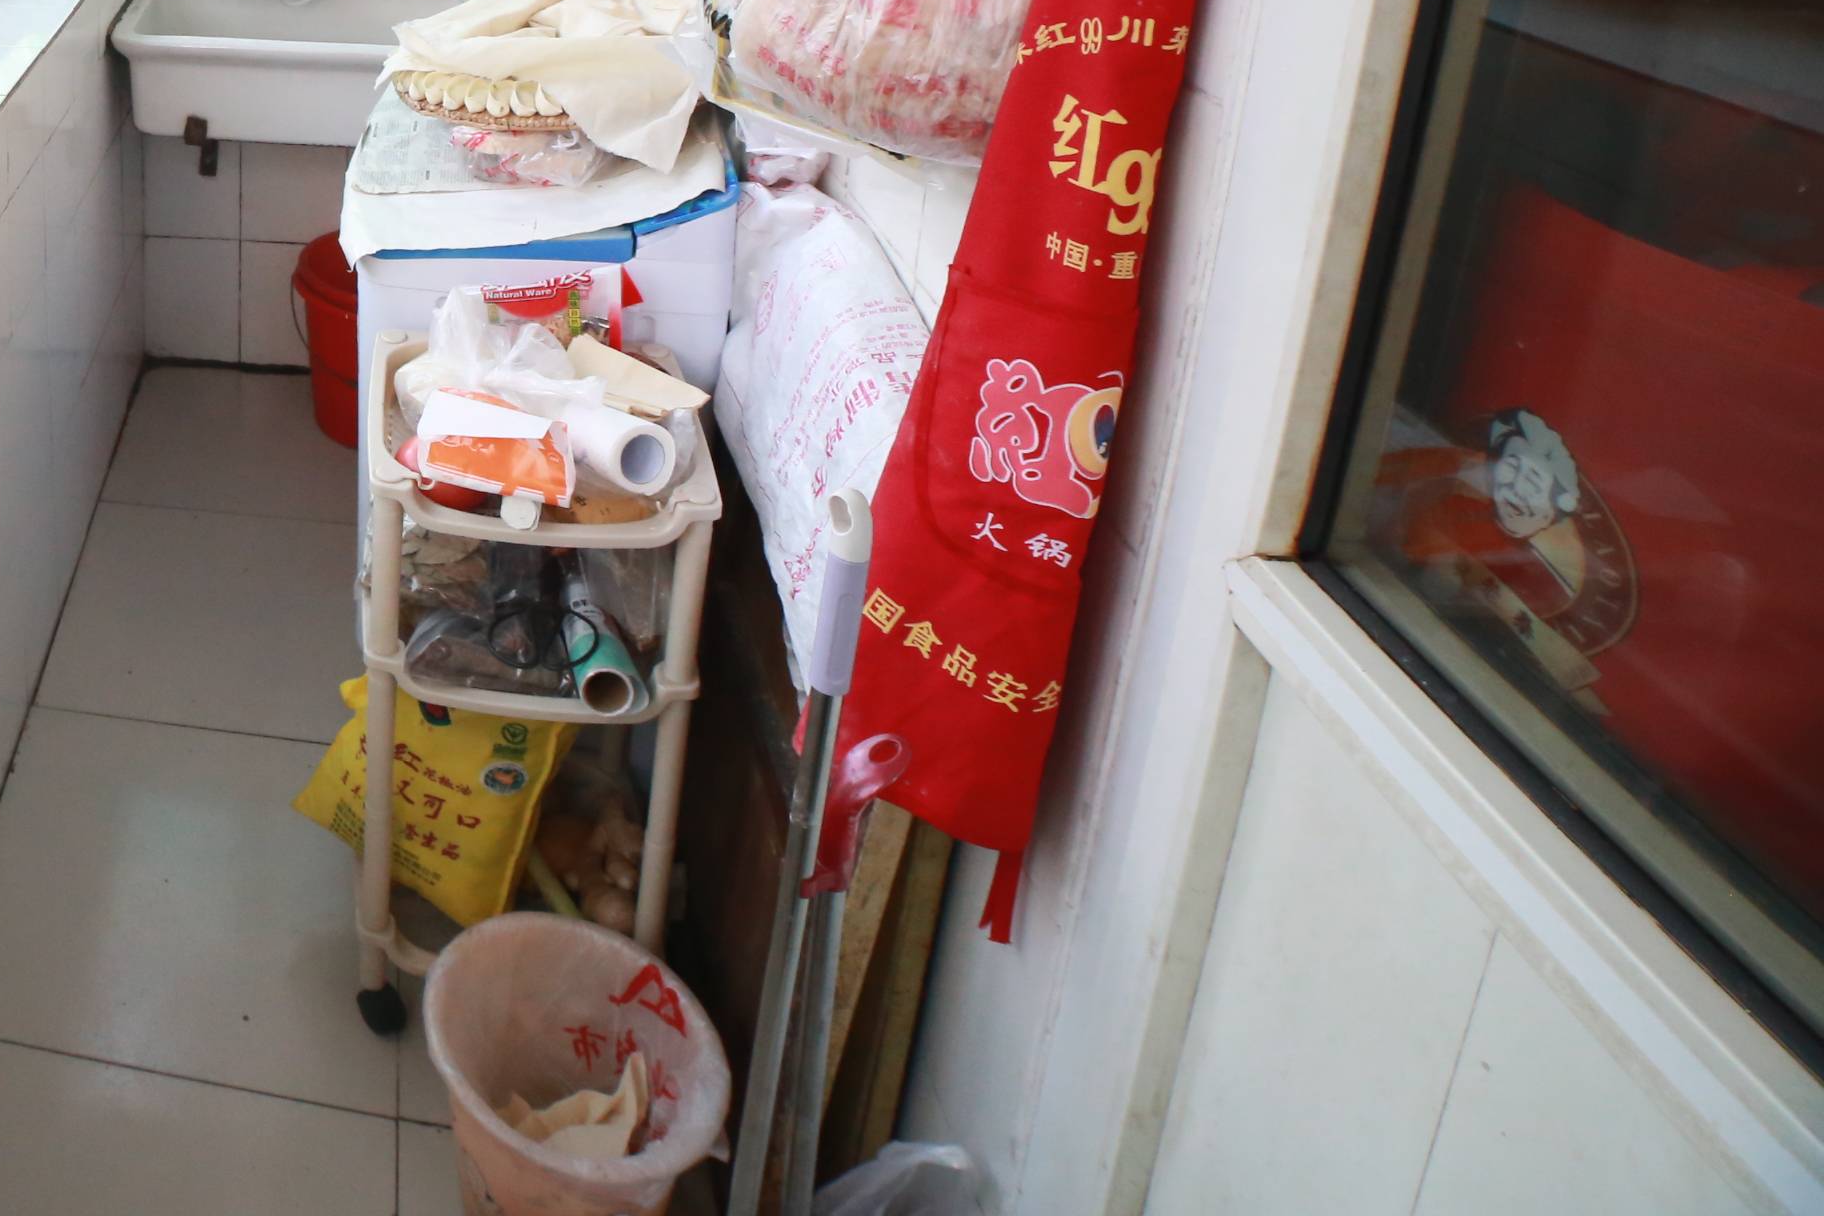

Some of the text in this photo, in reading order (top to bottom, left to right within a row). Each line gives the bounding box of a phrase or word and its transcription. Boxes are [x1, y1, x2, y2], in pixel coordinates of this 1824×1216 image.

[485, 287, 552, 300] Natural Ware
[970, 512, 1072, 568] 火锅
